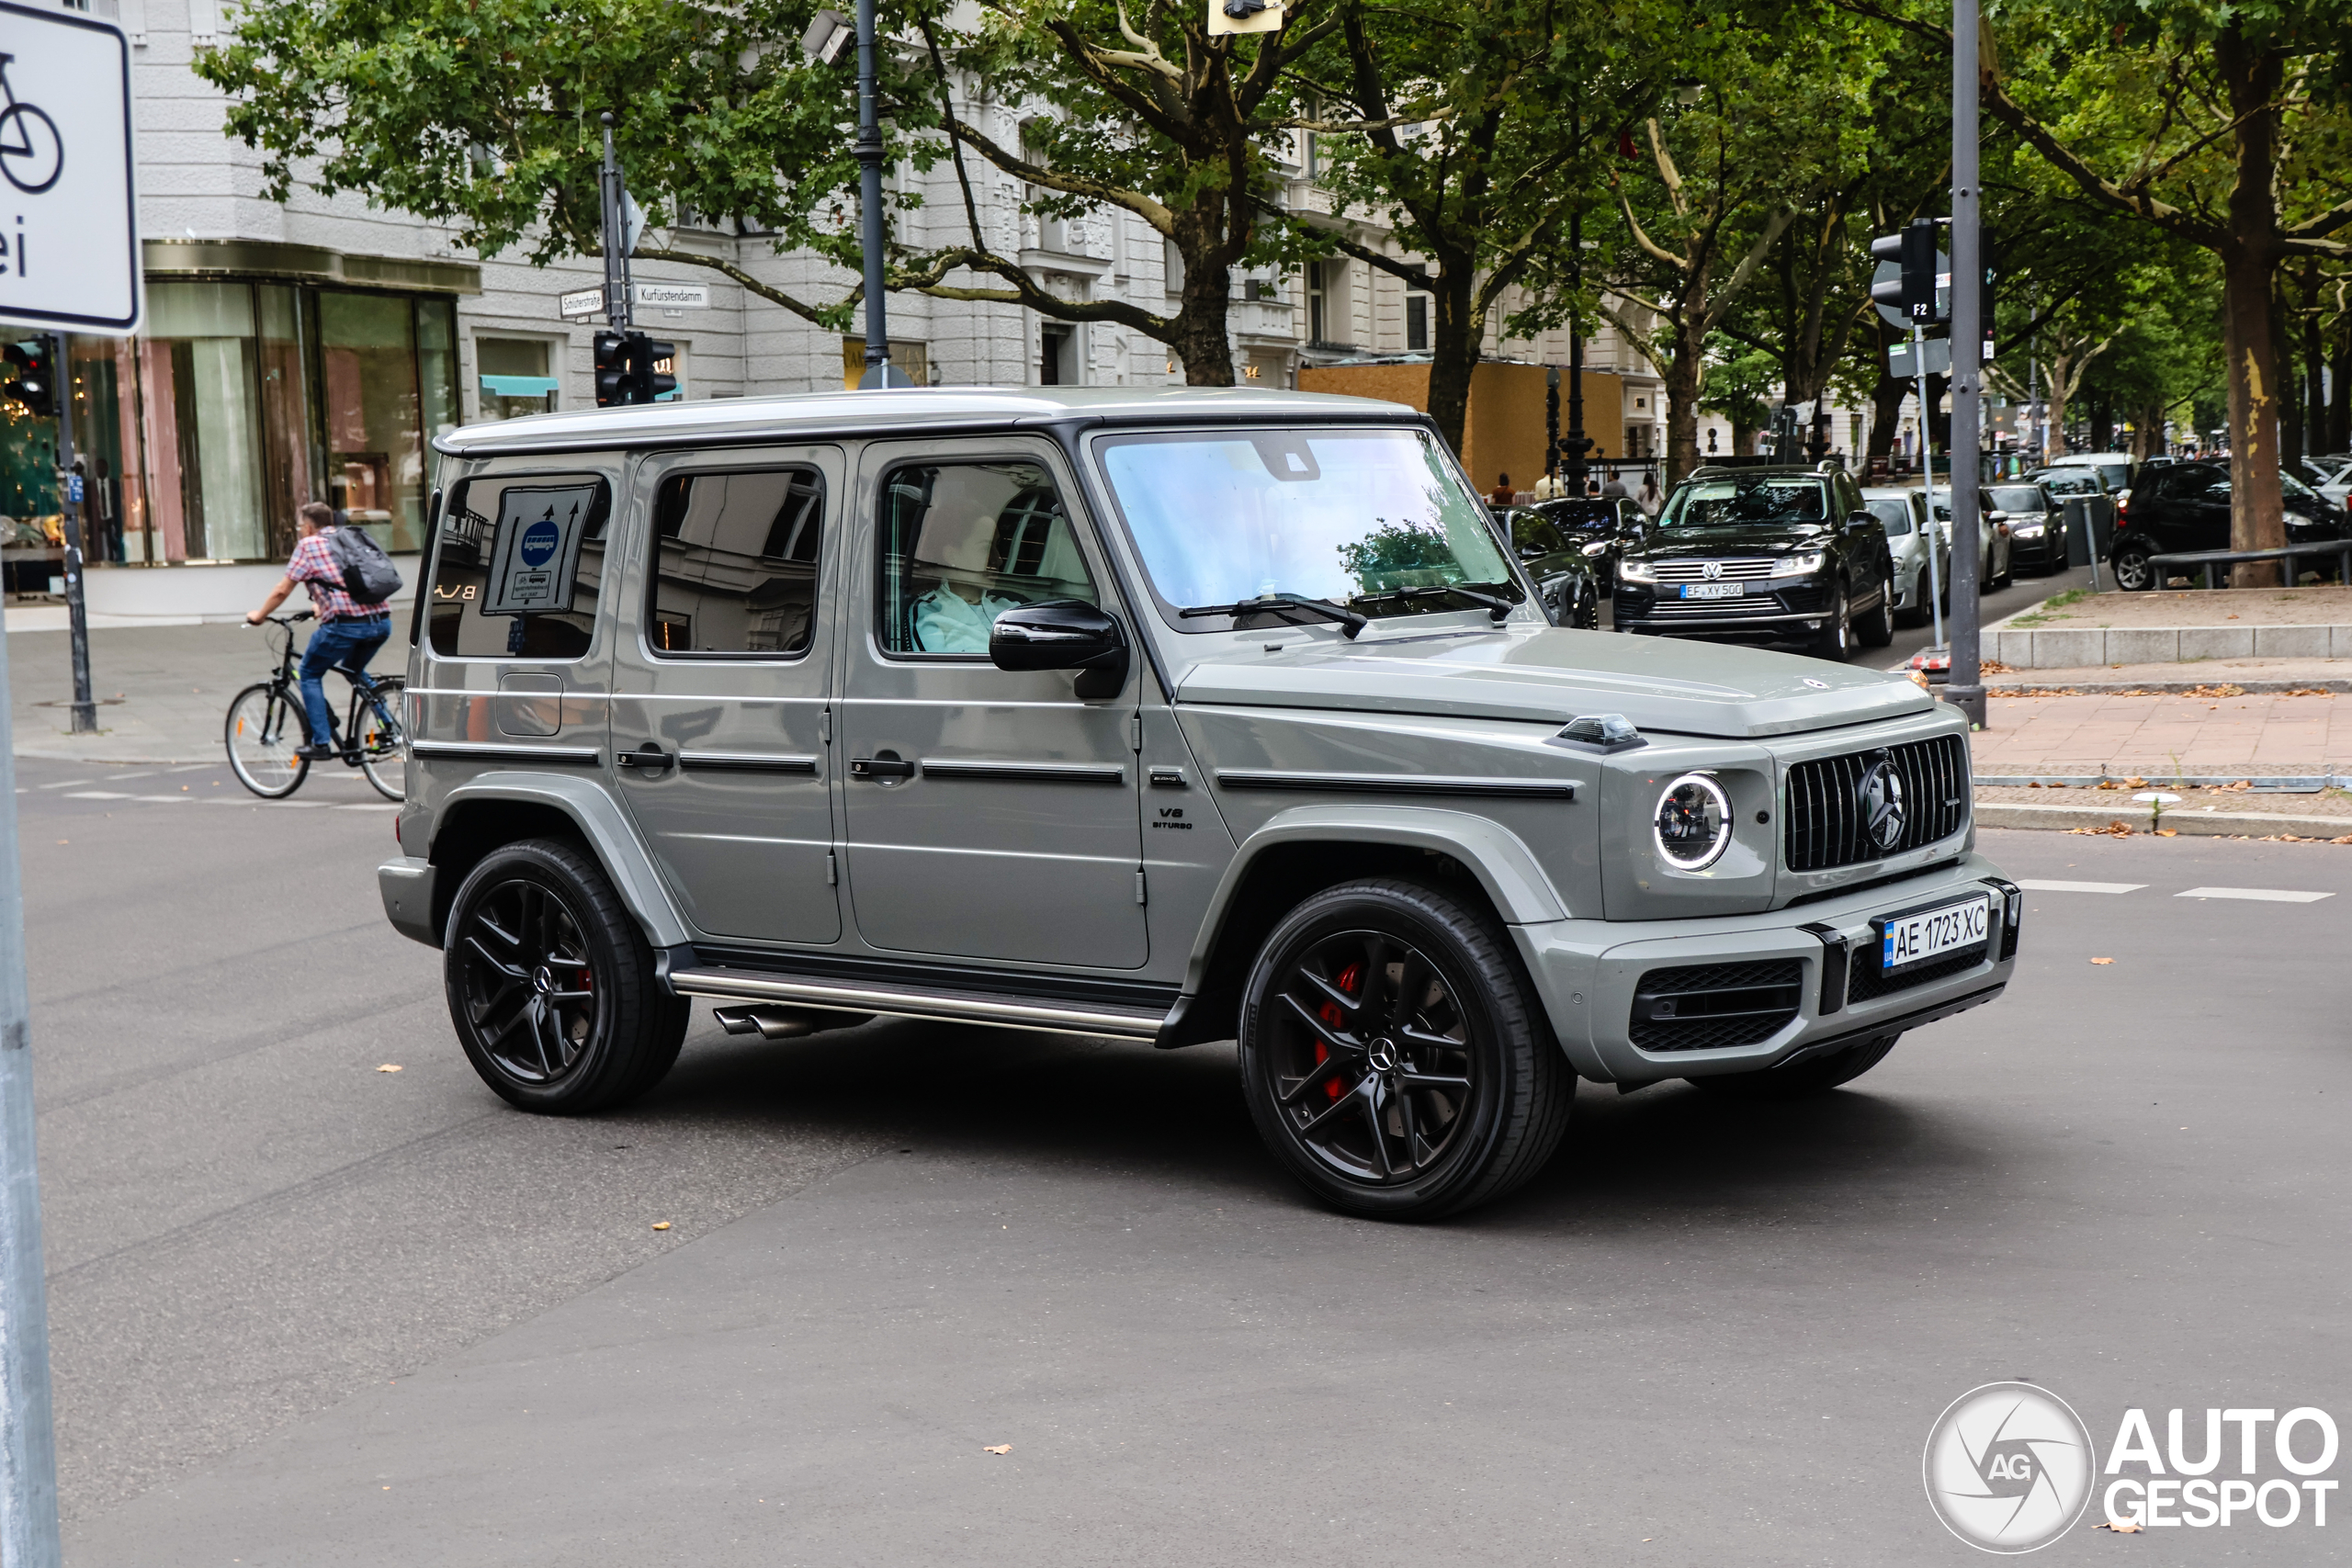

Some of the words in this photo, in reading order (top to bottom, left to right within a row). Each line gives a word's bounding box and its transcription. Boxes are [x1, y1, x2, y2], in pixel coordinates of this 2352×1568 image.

[564, 292, 600, 310] Schlüterstraße
[641, 288, 702, 302] Kurfürstendamm
[1913, 303, 1928, 316] F2
[1687, 586, 1701, 597] EF
[1707, 585, 1721, 595] XY
[1722, 584, 1742, 595] 500
[1159, 808, 1183, 818] V8
[1895, 922, 1919, 959] AE
[1925, 911, 1960, 950] 1723
[1962, 905, 1984, 941] XC
[1884, 952, 1893, 963] UA
